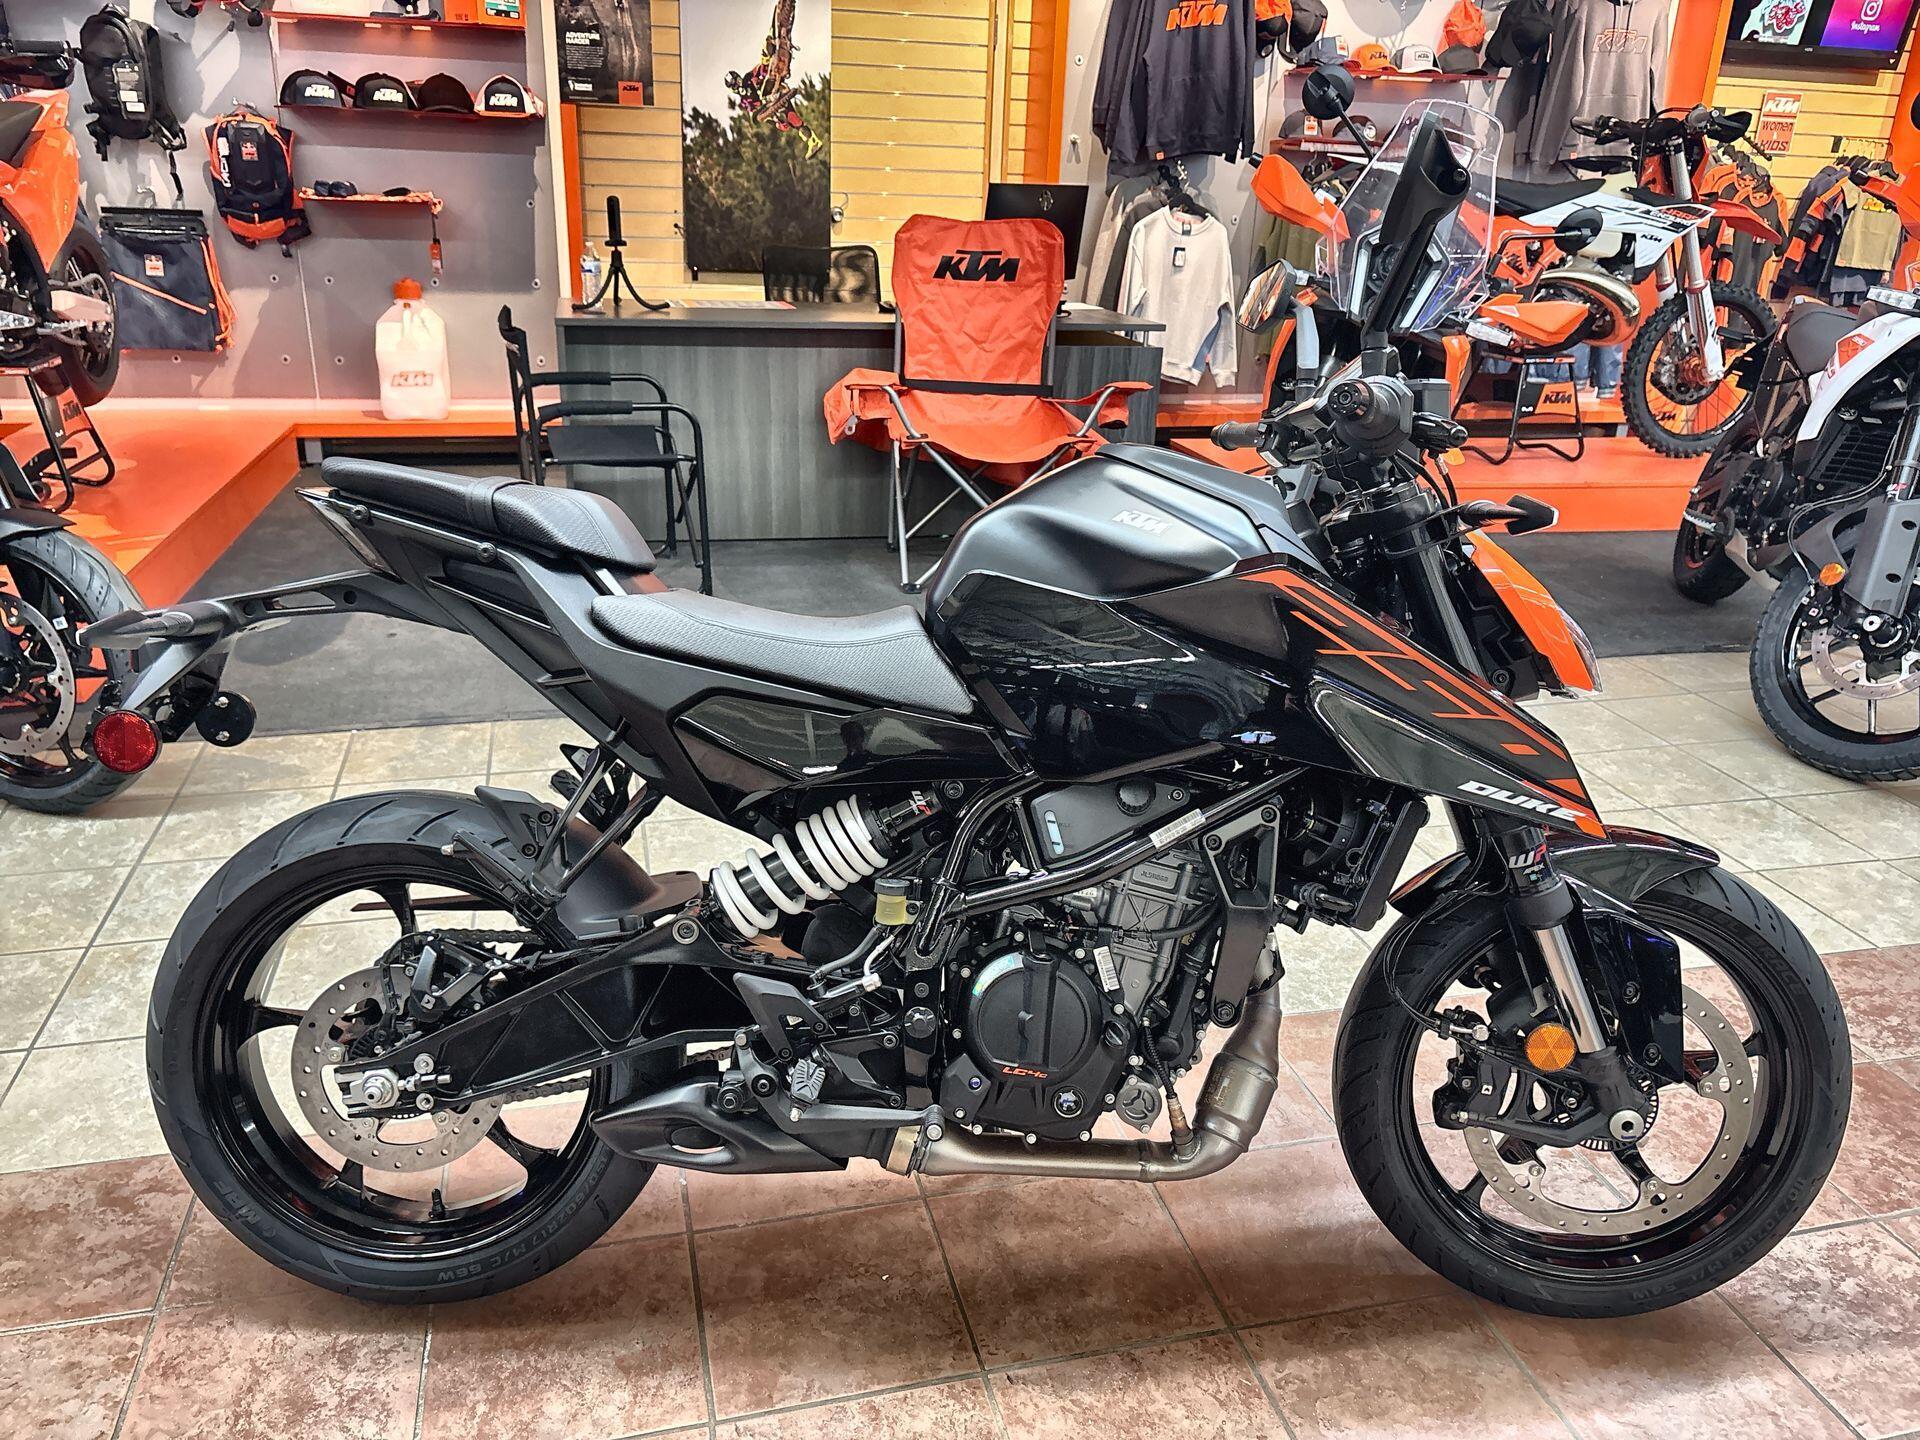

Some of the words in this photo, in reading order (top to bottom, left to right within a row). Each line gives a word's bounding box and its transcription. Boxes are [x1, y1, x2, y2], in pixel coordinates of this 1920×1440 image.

[1166, 0, 1228, 31] KTM
[1851, 20, 1881, 34] Instagram
[1592, 28, 1648, 54] KTM
[304, 84, 335, 99] KTM
[373, 88, 403, 103] KTM
[622, 84, 639, 92] KTM
[489, 93, 518, 107] KTM
[1764, 96, 1801, 113] KTM
[932, 249, 1020, 282] KTM
[391, 371, 434, 387] KTM
[1543, 390, 1572, 404] KTM
[1112, 510, 1168, 536] KTM
[1457, 781, 1586, 821] DUKE
[1508, 843, 1547, 869] WP
